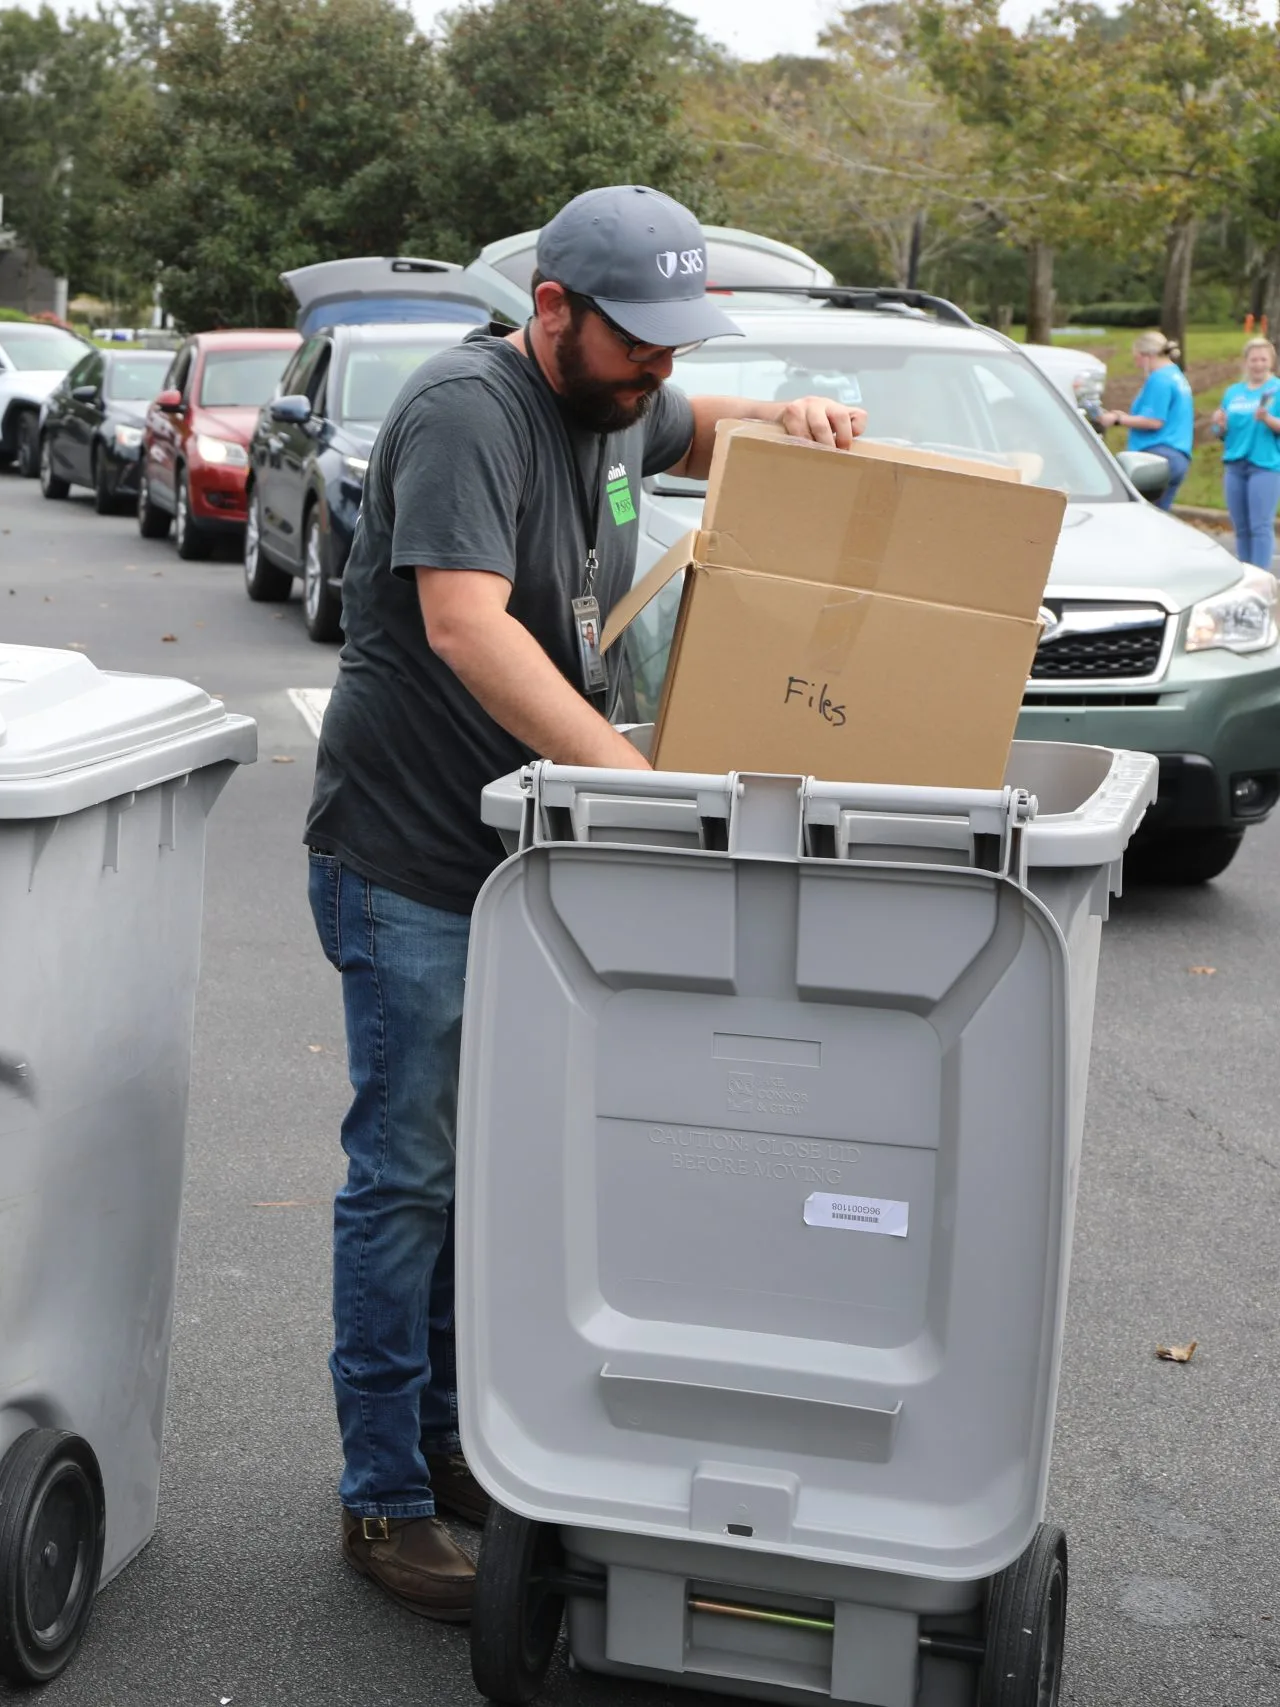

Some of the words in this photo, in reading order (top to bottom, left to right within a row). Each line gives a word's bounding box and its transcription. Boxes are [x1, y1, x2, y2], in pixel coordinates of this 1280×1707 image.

[680, 248, 704, 274] SRS
[784, 676, 846, 727] Files
[649, 1127, 749, 1152] CAUTION:
[755, 1138, 821, 1160] CLOSE
[827, 1144, 862, 1164] LID
[671, 1152, 750, 1176] BEFORE
[752, 1160, 843, 1185] MOVING
[831, 1202, 881, 1216] 96G001108
